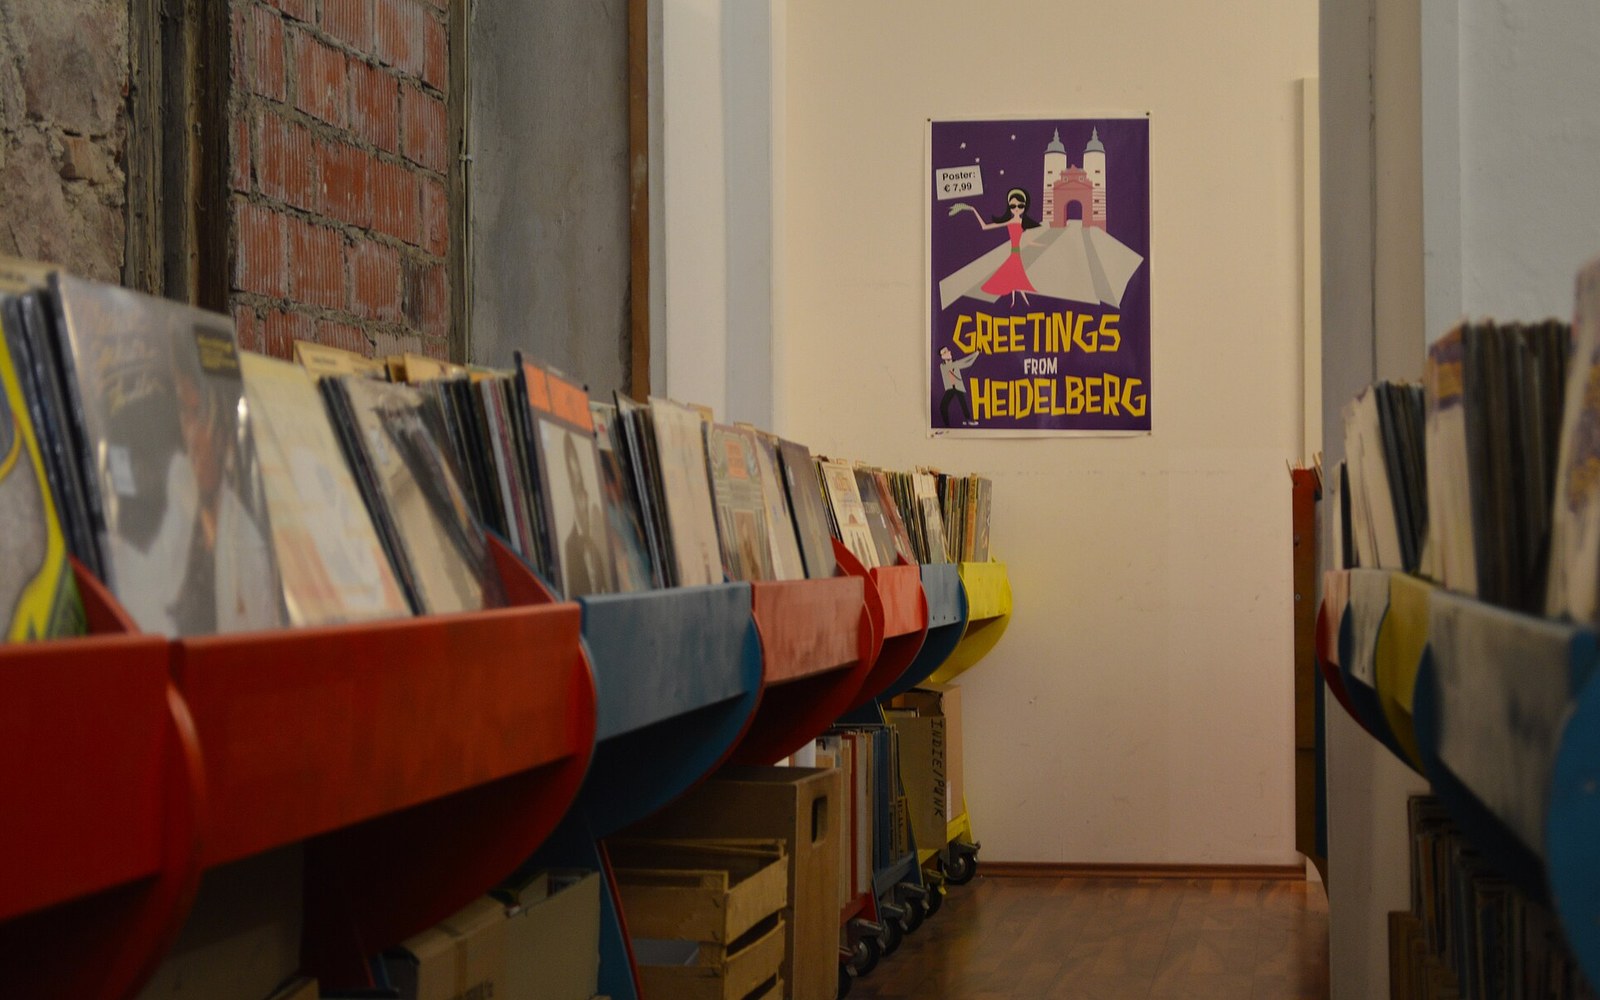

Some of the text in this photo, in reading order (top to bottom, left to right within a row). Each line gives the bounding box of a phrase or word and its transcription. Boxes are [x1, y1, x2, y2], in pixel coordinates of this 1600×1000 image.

[942, 171, 976, 181] Poster:
[944, 182, 972, 192] € 7,99
[953, 311, 1121, 354] GREETINGS
[1024, 357, 1058, 375] FROM
[970, 373, 1146, 419] HEIDELBERG
[931, 718, 945, 818] INDIE/PUNK
